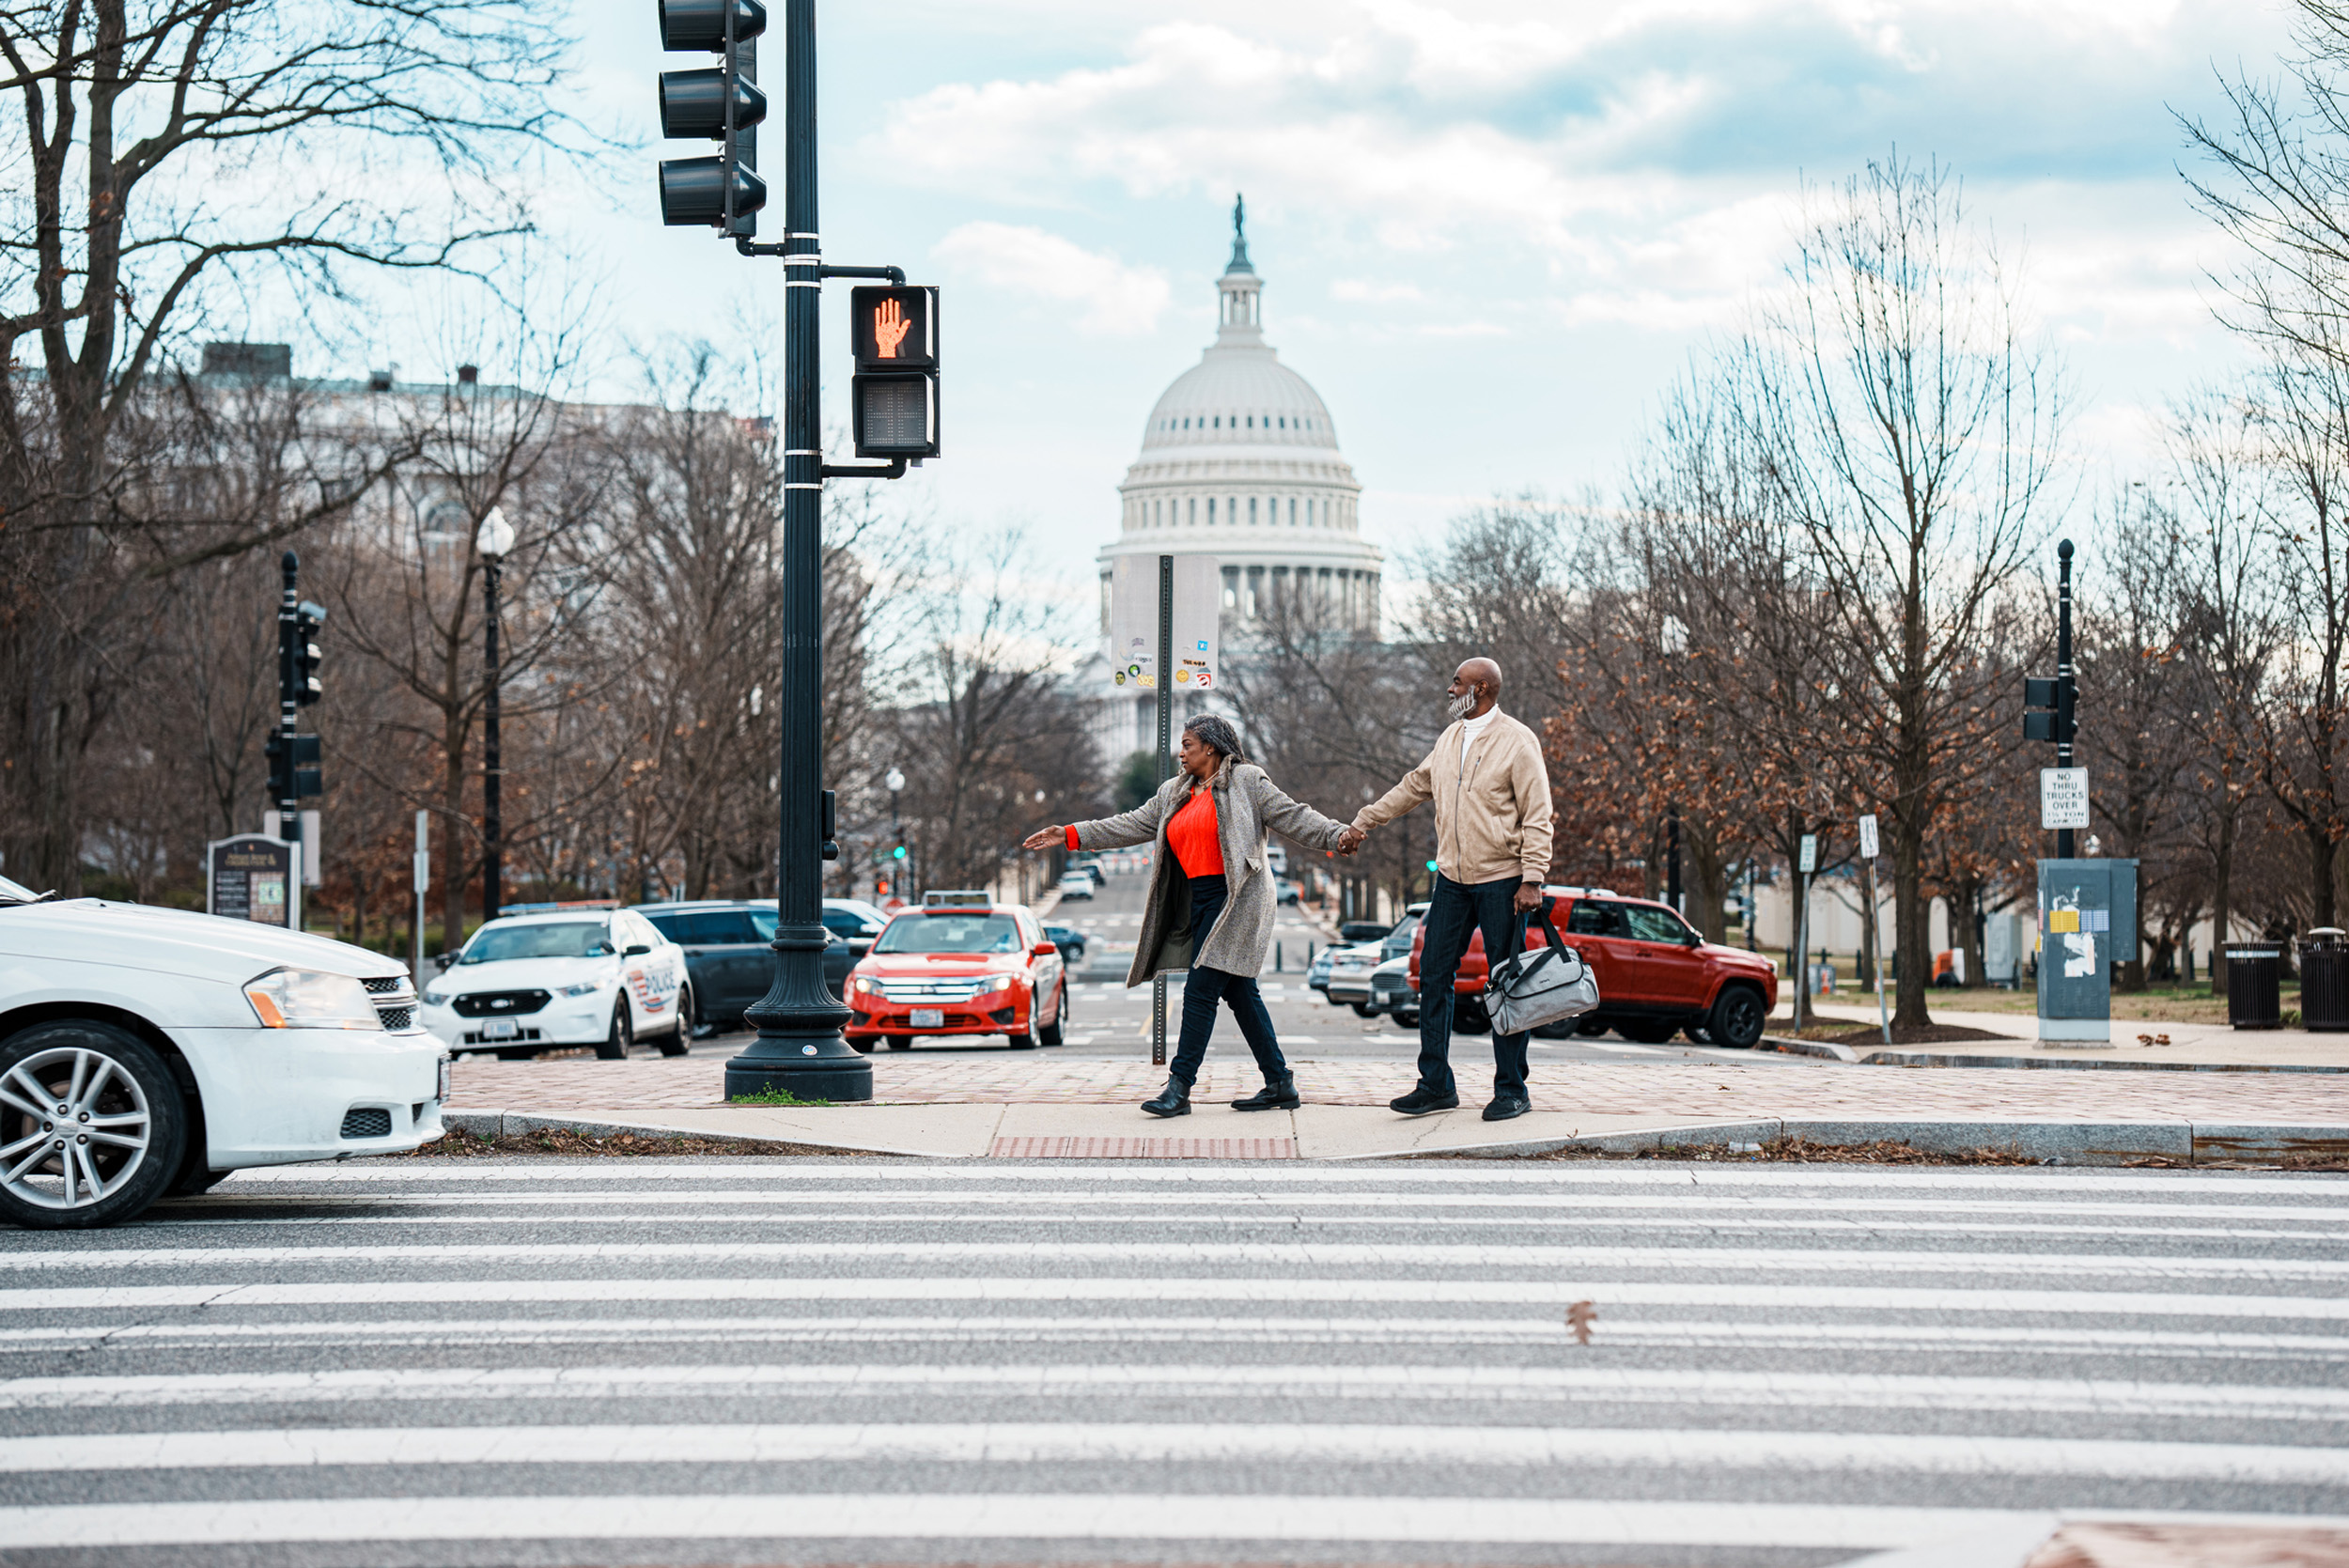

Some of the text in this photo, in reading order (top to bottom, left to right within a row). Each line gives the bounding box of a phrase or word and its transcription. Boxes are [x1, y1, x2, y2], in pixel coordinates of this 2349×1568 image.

[2057, 772, 2071, 781] NO
[2052, 782, 2077, 790] THRU
[2046, 791, 2084, 800] TRUCKS
[2052, 801, 2077, 810] OVER
[646, 970, 677, 994] POLICE
